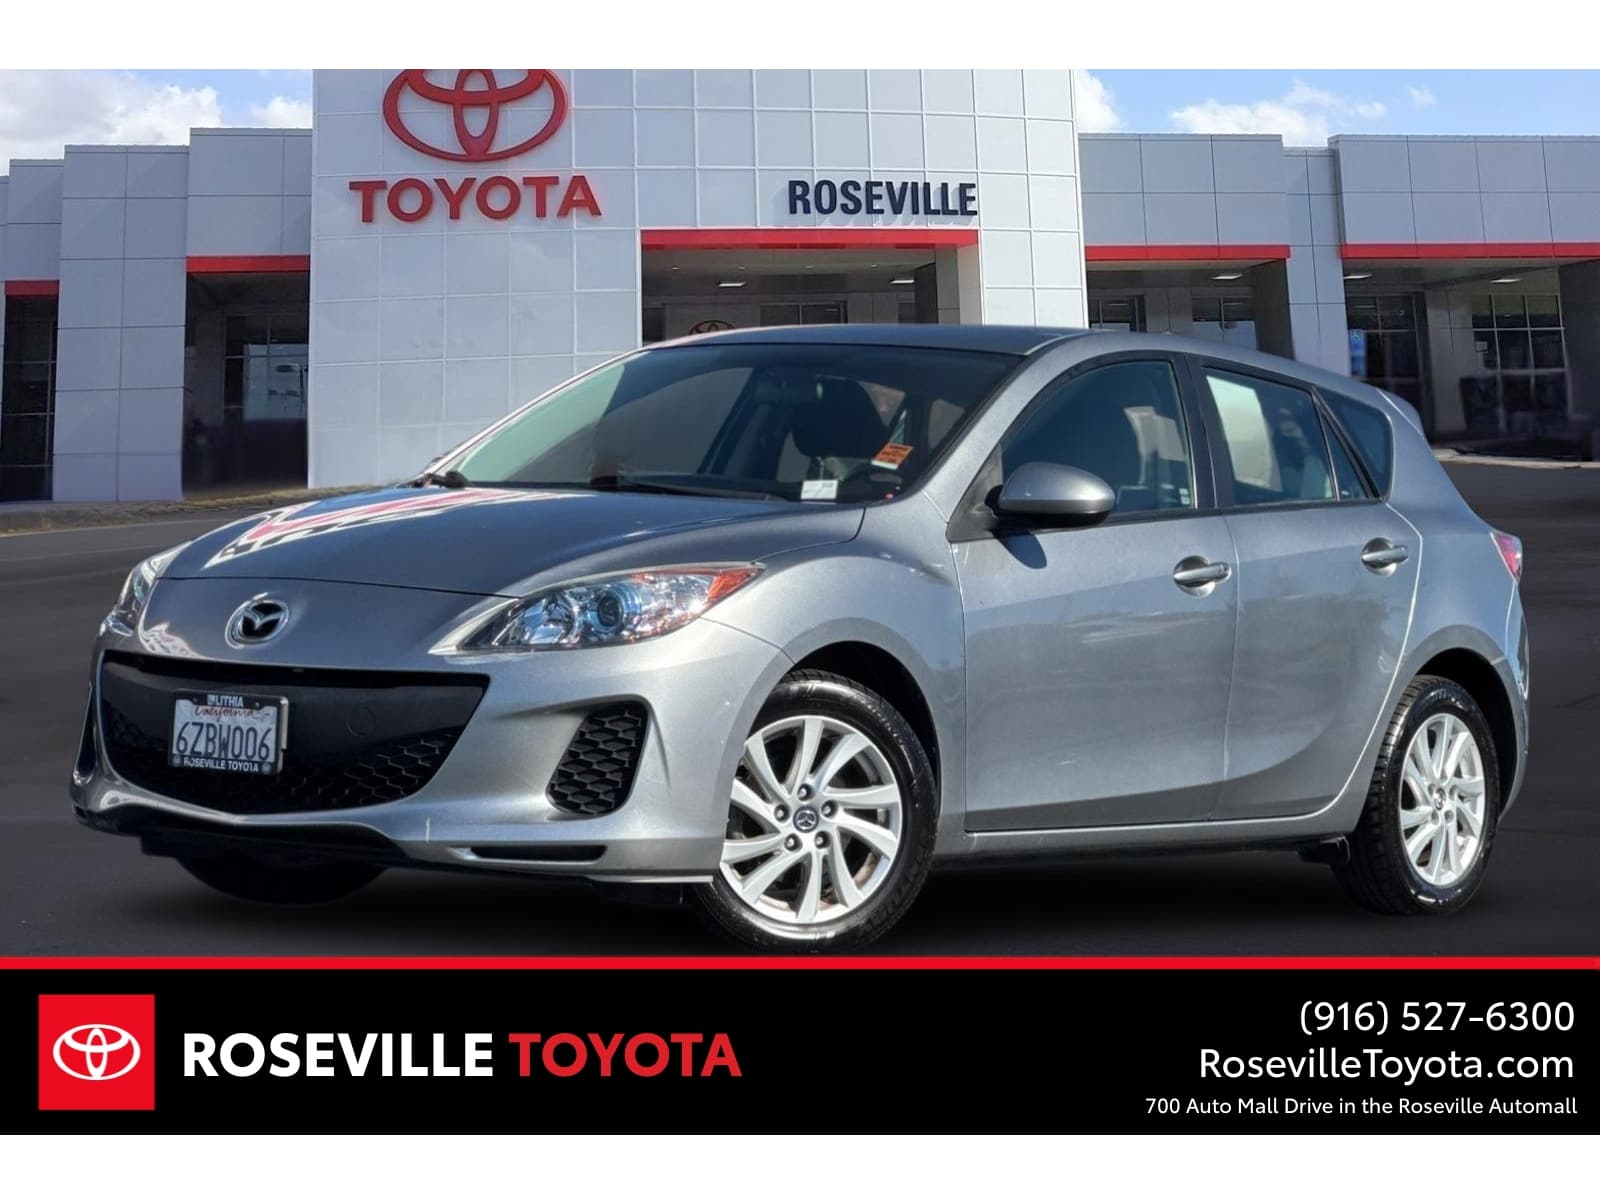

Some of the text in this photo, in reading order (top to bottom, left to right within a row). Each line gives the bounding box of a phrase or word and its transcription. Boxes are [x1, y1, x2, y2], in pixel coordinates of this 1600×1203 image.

[350, 175, 602, 223] TOYOTA
[788, 179, 978, 217] ROSEVILLE
[215, 695, 244, 708] LITHIA
[175, 720, 273, 761] 6ZBW006
[183, 757, 259, 773] ROSEVILLE TOYOTA
